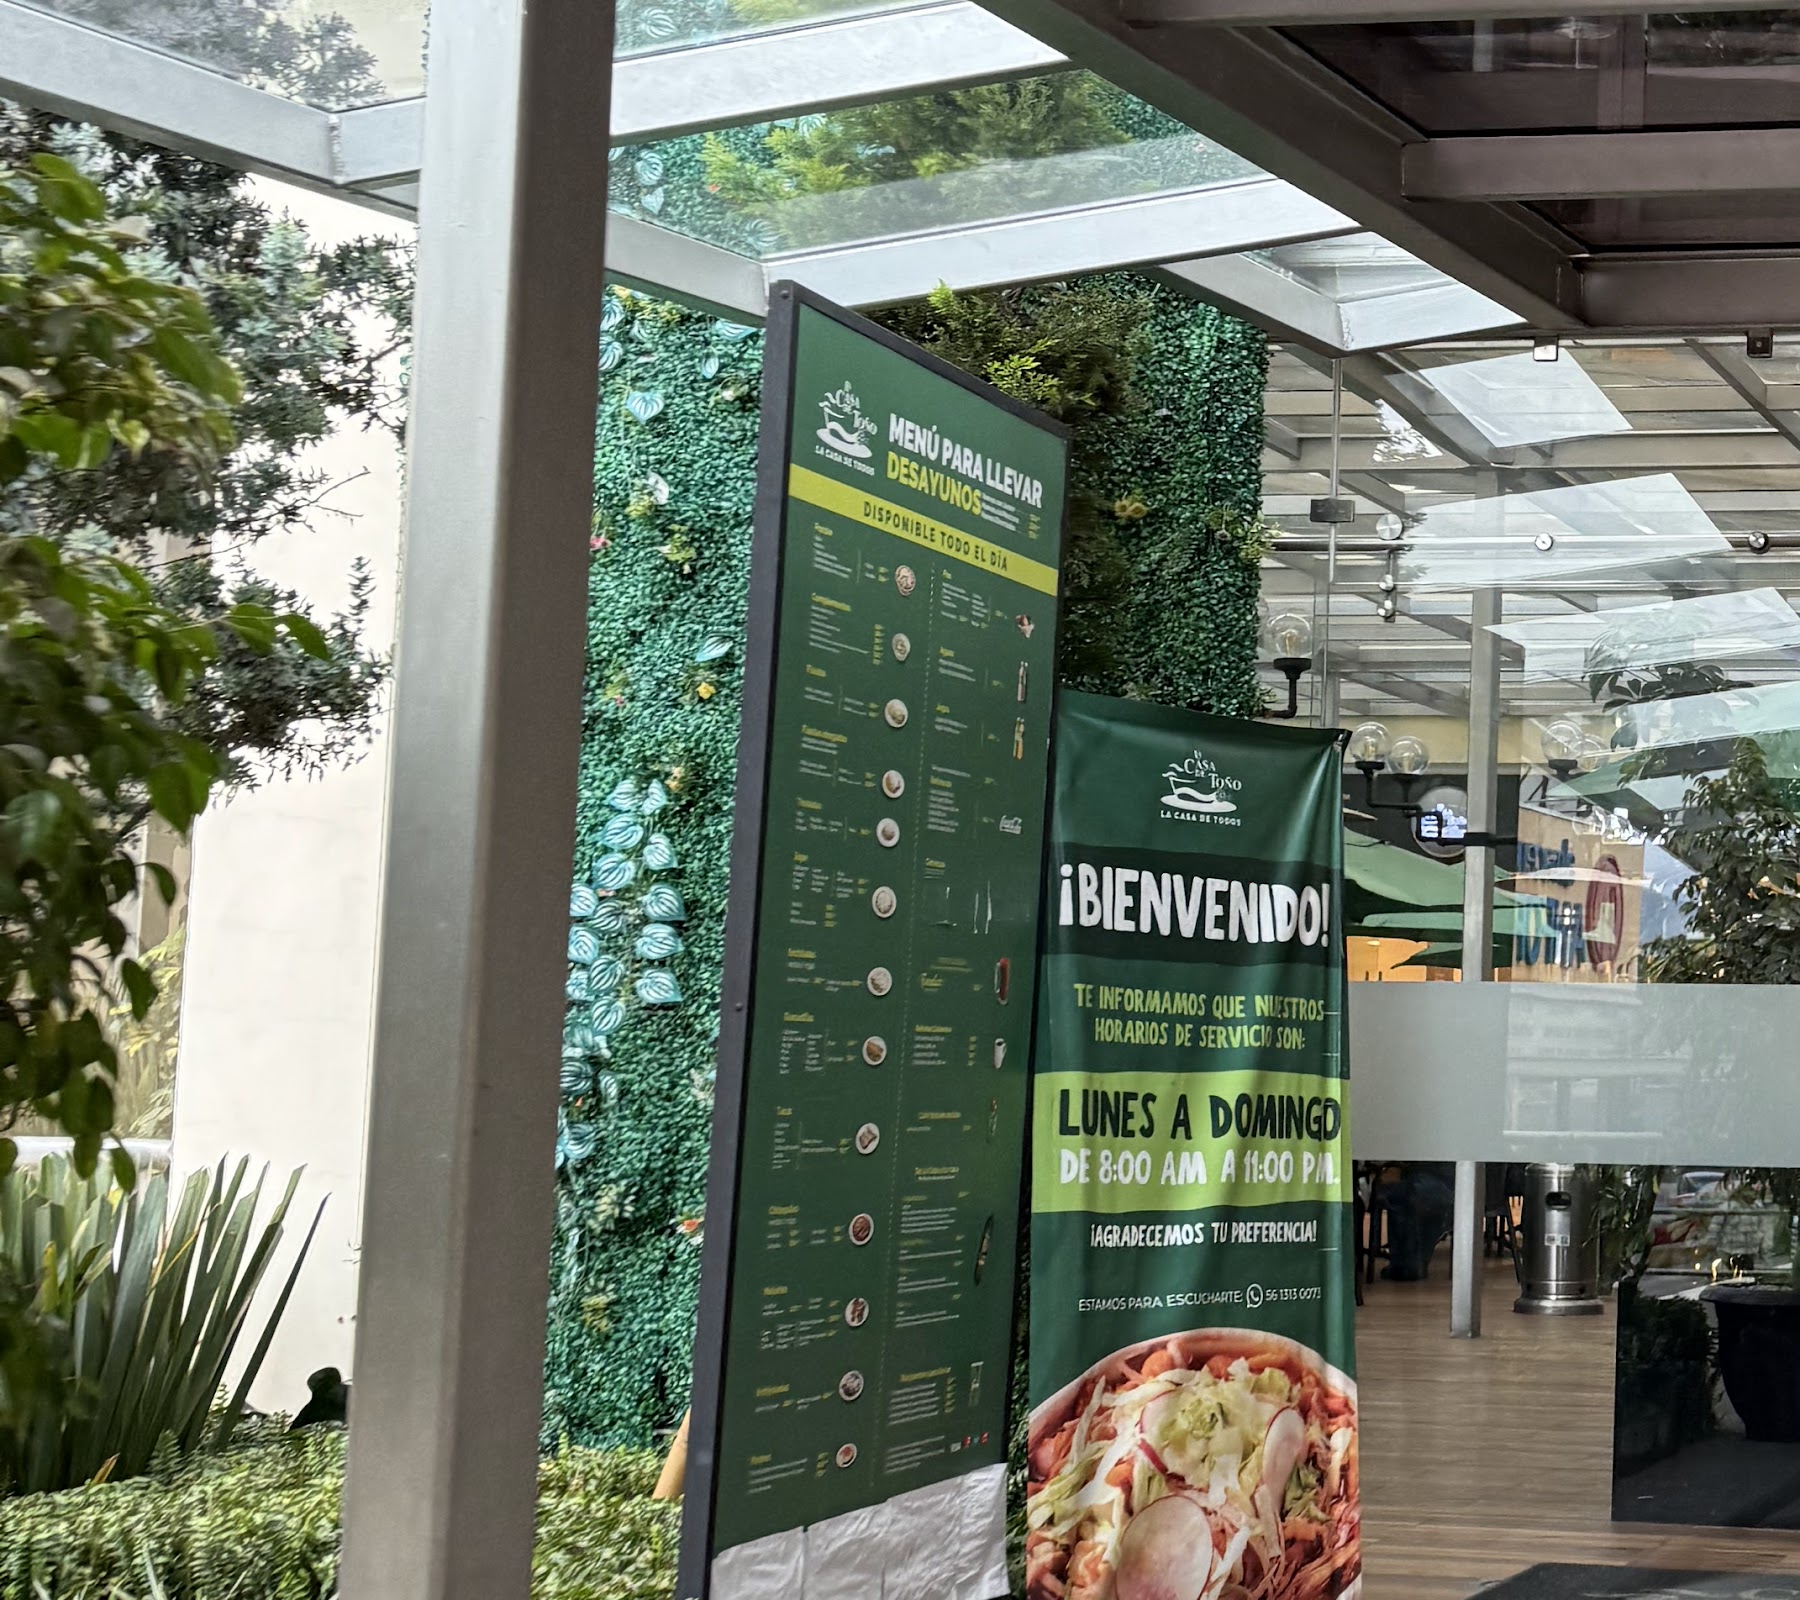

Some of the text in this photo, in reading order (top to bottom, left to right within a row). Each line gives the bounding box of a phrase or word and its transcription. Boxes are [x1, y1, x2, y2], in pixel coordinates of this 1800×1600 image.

[889, 413, 1042, 509] MENÚ PARA LLEVAR
[887, 451, 982, 516] DESAYUNOS
[863, 501, 936, 543] DISPONIBLE
[940, 532, 970, 556] TODO
[975, 545, 986, 563] EL
[1184, 758, 1216, 775] CASA
[1208, 773, 1242, 791] TOÑO
[1160, 810, 1172, 819] LA
[1174, 811, 1197, 822] CASA
[1059, 863, 1330, 947] ¡BIENVENIDO!
[1074, 983, 1324, 1021] TE INFORMAMOS QUE NUESTROS
[1094, 1017, 1305, 1050] HORARIOS DE SERVICIO SON:
[1059, 1088, 1341, 1142] LUNES A DOMINGO
[1060, 1148, 1091, 1184] DE
[1099, 1149, 1152, 1185] 8:00
[1220, 1148, 1235, 1183] A
[1244, 1150, 1294, 1184] 11:00
[1091, 1220, 1317, 1248] ¡AGRADECEMOS TU PREFERENCIA!
[1079, 1297, 1127, 1311] ESTAMOS
[1128, 1295, 1163, 1309] PARA
[1166, 1290, 1243, 1308] ESCUCHARTE
